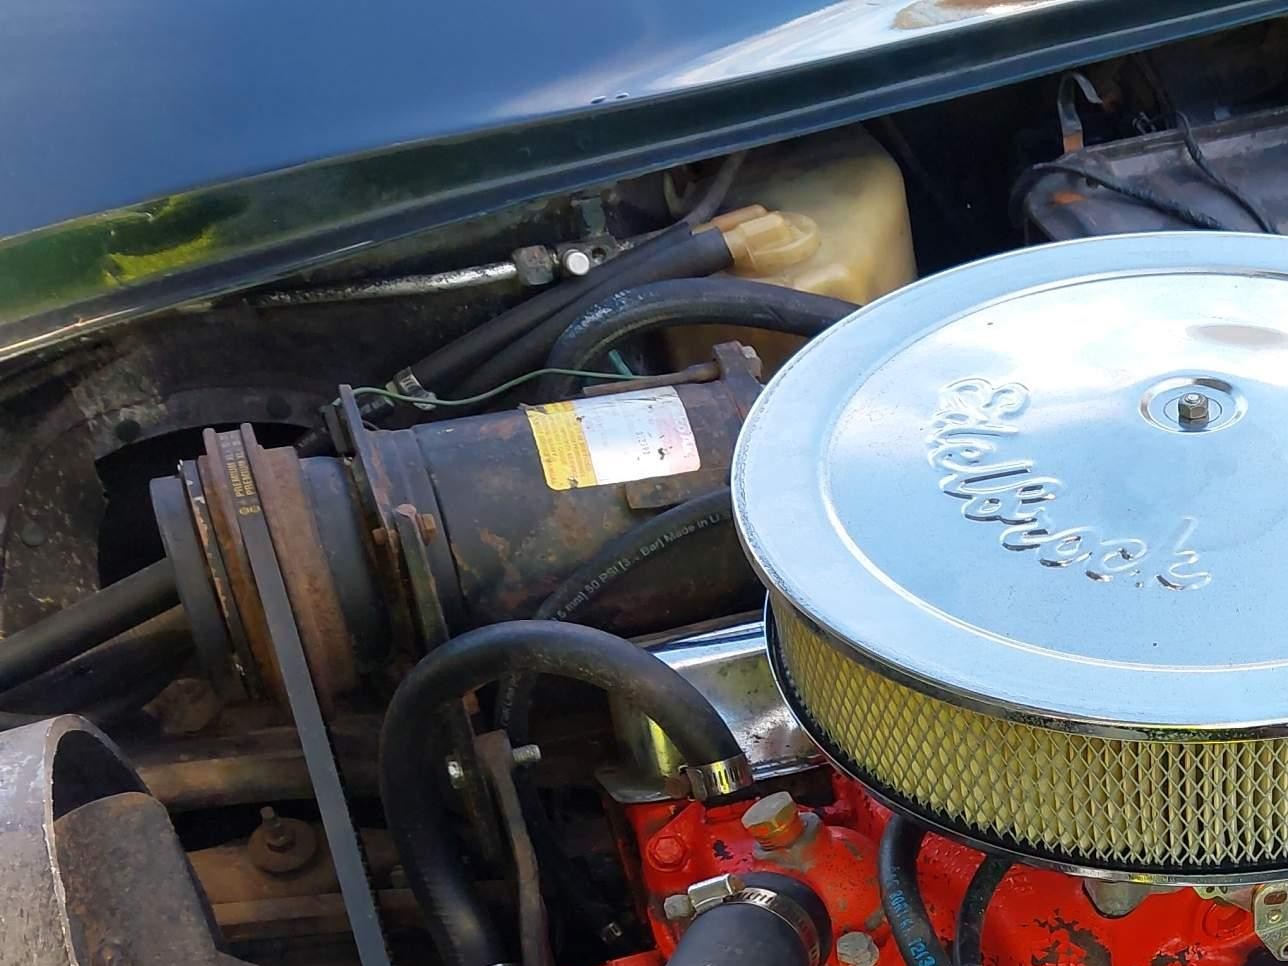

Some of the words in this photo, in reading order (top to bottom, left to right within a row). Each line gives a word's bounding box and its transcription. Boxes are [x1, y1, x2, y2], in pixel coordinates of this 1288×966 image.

[663, 526, 696, 544] Made
[697, 519, 709, 529] in
[924, 377, 1213, 591] Edelbrock
